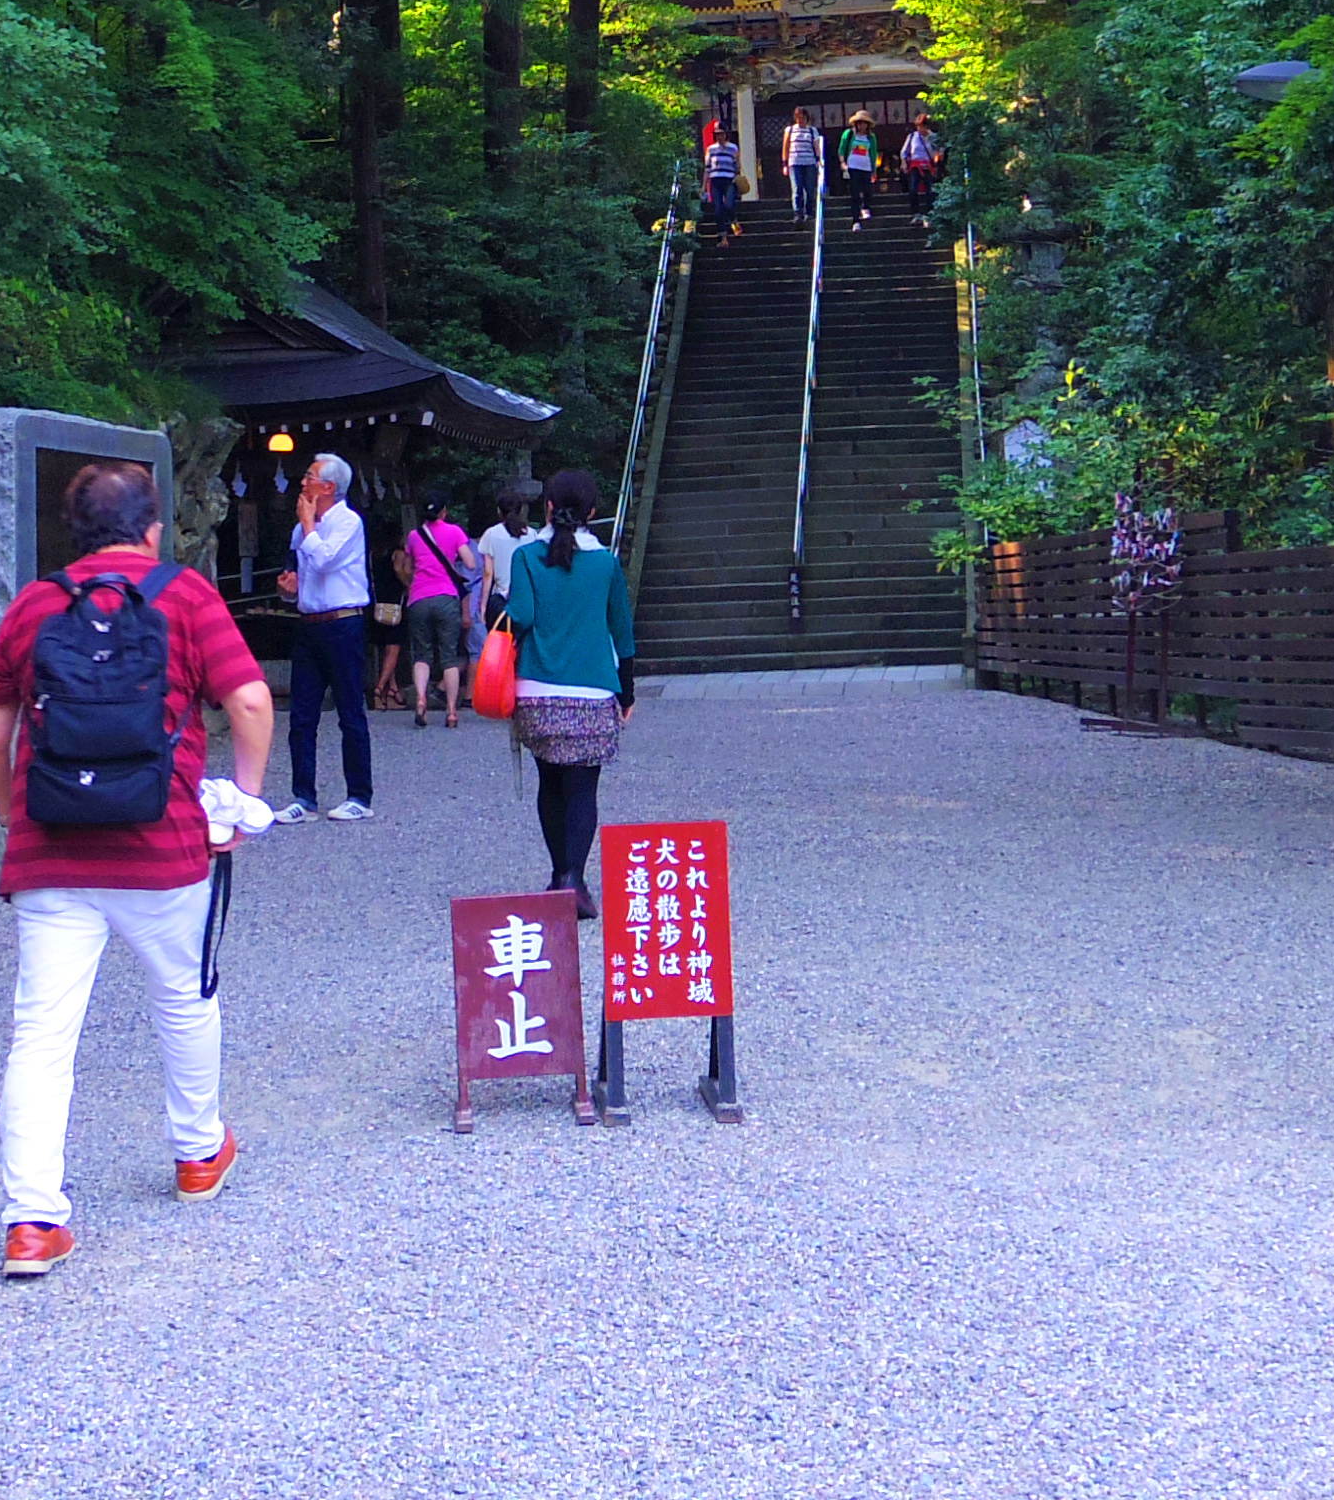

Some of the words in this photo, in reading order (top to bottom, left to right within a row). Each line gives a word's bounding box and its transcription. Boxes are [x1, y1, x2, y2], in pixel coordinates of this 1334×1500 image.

[611, 953, 626, 1005] 社務所
[625, 840, 653, 1004] ご遠慮下さい
[654, 838, 681, 976] 犬の散歩は
[685, 840, 714, 1004] これより神域
[483, 914, 553, 1059] 車止
